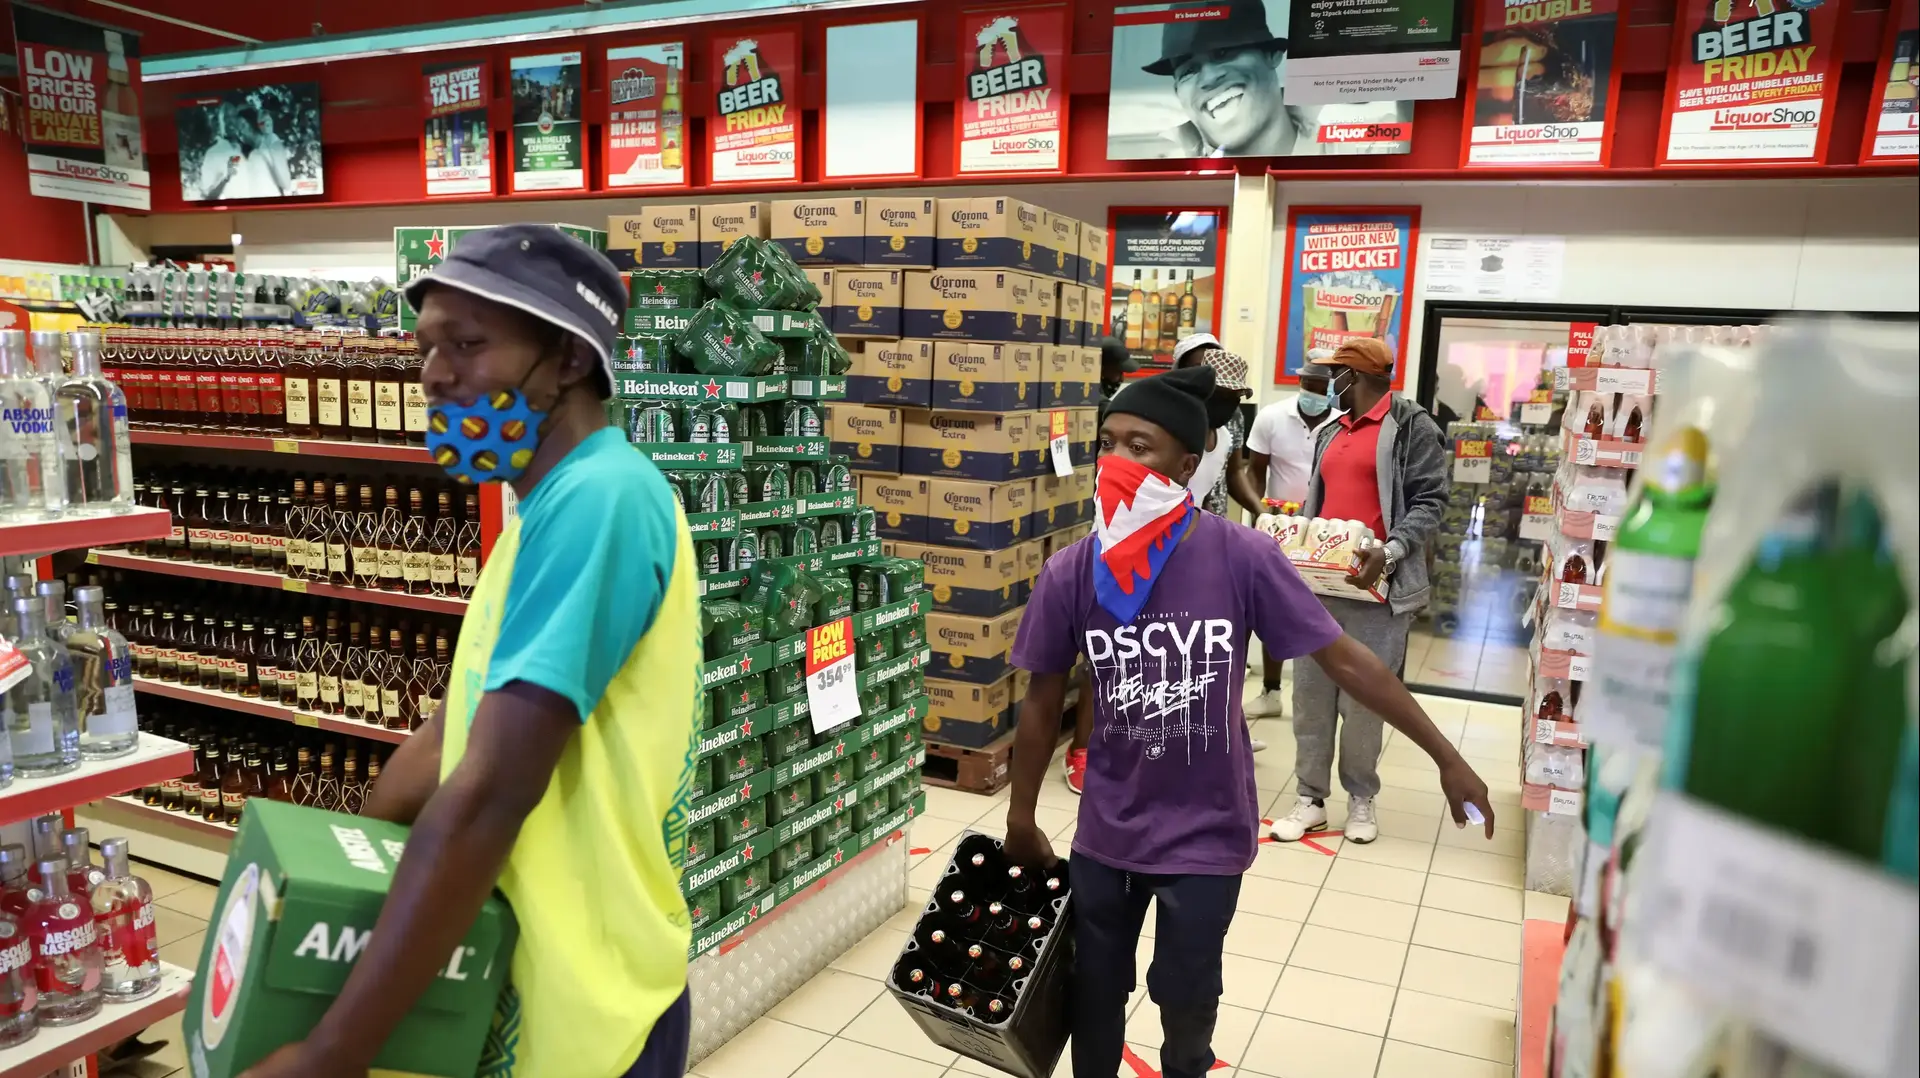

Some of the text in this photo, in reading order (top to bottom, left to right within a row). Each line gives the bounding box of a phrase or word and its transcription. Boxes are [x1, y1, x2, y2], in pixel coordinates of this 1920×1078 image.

[1175, 10, 1184, 19] It's
[1200, 10, 1221, 18] o'clock
[1311, 2, 1333, 10] enjoy
[1505, 0, 1592, 26] DOUBLE
[1698, 11, 1803, 61] BEER
[24, 47, 93, 81] LOW
[1704, 45, 1816, 84] FRIDAY
[429, 66, 480, 88] FOR EVERY
[971, 59, 1043, 99] BEER
[1679, 73, 1824, 99] SAVE WITH OUR UNBELIEVABLE
[26, 76, 96, 99] PRICES
[430, 78, 481, 108] TASTE
[720, 77, 780, 115] BEER
[1679, 83, 1823, 108] BEER SPECIALS EVERY FRIDAY!
[28, 93, 97, 115] ON OUR
[977, 88, 1052, 119] FRIDAY
[29, 110, 99, 130] PRIVATE
[726, 104, 787, 133] FRIDAY
[1714, 107, 1816, 125] LiquorShop
[31, 125, 100, 145] LABELS
[1326, 124, 1401, 141] LiquorShop
[1495, 125, 1578, 139] LiquorShop
[992, 138, 1053, 150] LiquorShop
[737, 149, 793, 161] LiquorShop
[56, 159, 129, 182] LiquorShop
[793, 204, 838, 219] Corona
[880, 207, 917, 221] Corona
[952, 209, 989, 223] Corona
[804, 217, 828, 227] Extra
[889, 219, 909, 228] Extra
[961, 220, 981, 229] Extra
[1310, 222, 1394, 233] GET THE PARTY STARTED
[1308, 231, 1396, 249] WITH OUR NEW
[1301, 248, 1398, 271] ICE BUCKET
[734, 265, 765, 302] Heineken
[930, 273, 976, 291] Corona
[641, 295, 679, 306] Heineken
[942, 288, 967, 299] Extra
[1316, 289, 1382, 307] LiquorShop
[1314, 331, 1340, 343] MADE
[1573, 331, 1593, 339] PULL
[702, 331, 736, 366] Heineken
[948, 352, 985, 366] Corona
[958, 363, 978, 373] Extra
[624, 379, 699, 396] Heineken
[1599, 376, 1618, 384] BRUTAL
[11, 421, 54, 434] VODKA
[930, 415, 976, 432] Corona
[941, 428, 966, 440] Extra
[652, 449, 730, 462] Heineken 24
[756, 442, 819, 453] Heineken 24
[807, 497, 851, 510] Heineken 24
[229, 533, 251, 543] BOL
[1312, 532, 1349, 561] HANSA
[920, 551, 965, 568] Corona
[931, 563, 956, 576] Extra
[875, 606, 910, 626] Heineken
[813, 620, 845, 648] LOW
[1085, 618, 1233, 662] DSCVR
[157, 650, 178, 658] OLS
[813, 639, 847, 665] PRICE
[817, 665, 844, 691] 354
[877, 661, 911, 683] Heineken
[873, 714, 907, 737] Heineken
[792, 750, 834, 777] Heineken
[873, 766, 906, 789] Heineken
[687, 793, 737, 825] Heineken
[1553, 797, 1576, 806] BRUTAL
[792, 806, 833, 836] Heineken
[873, 815, 906, 839] Heineken
[689, 855, 740, 890] Heineken
[45, 919, 95, 945] ABSOLUT
[697, 917, 746, 953] Heineken
[294, 922, 476, 980] AML
